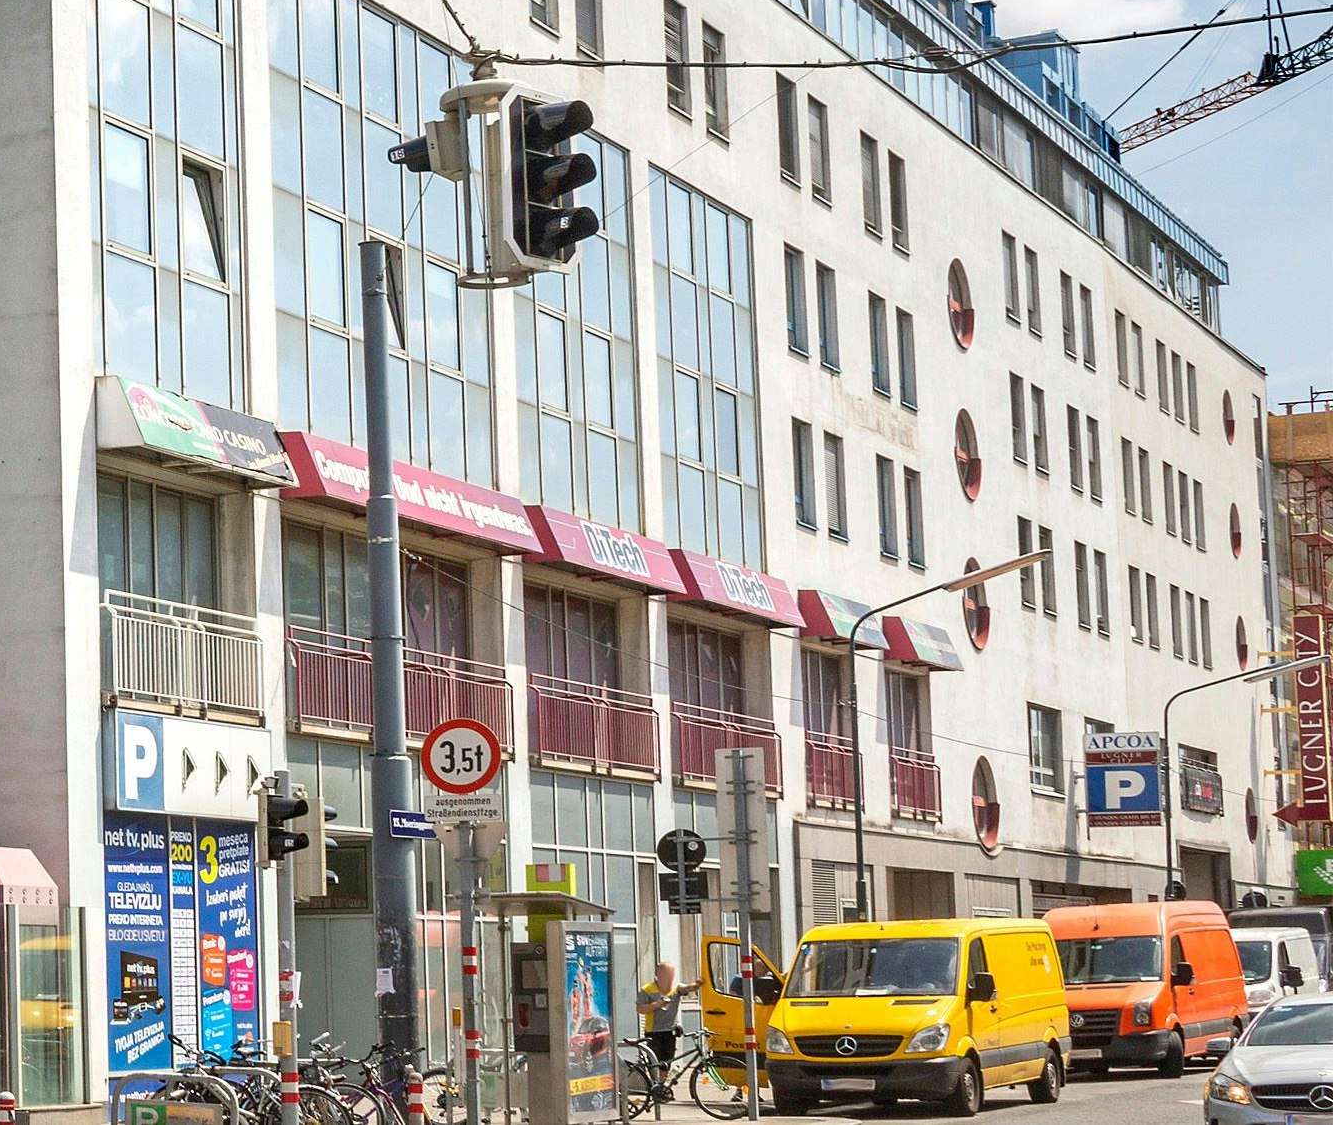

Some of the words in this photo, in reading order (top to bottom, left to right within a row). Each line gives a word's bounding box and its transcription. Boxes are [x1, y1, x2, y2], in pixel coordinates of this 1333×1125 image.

[581, 521, 649, 576] DiTech
[716, 560, 775, 611] DiTech
[1296, 632, 1320, 688] CTY
[1088, 735, 1155, 749] APCOA
[123, 724, 159, 800] P
[1300, 700, 1328, 805] LUGNER
[1104, 770, 1145, 809] P
[435, 798, 491, 808] ausgenommen
[105, 830, 124, 847] net
[127, 829, 165, 851] tv.plus
[171, 831, 192, 843] PREKO
[219, 832, 248, 846] meseca
[172, 844, 192, 862] 200
[199, 835, 218, 884] 3
[219, 845, 249, 862] pretplate
[218, 860, 250, 877] GRATIS!
[109, 893, 162, 910] TELEVIZIJU
